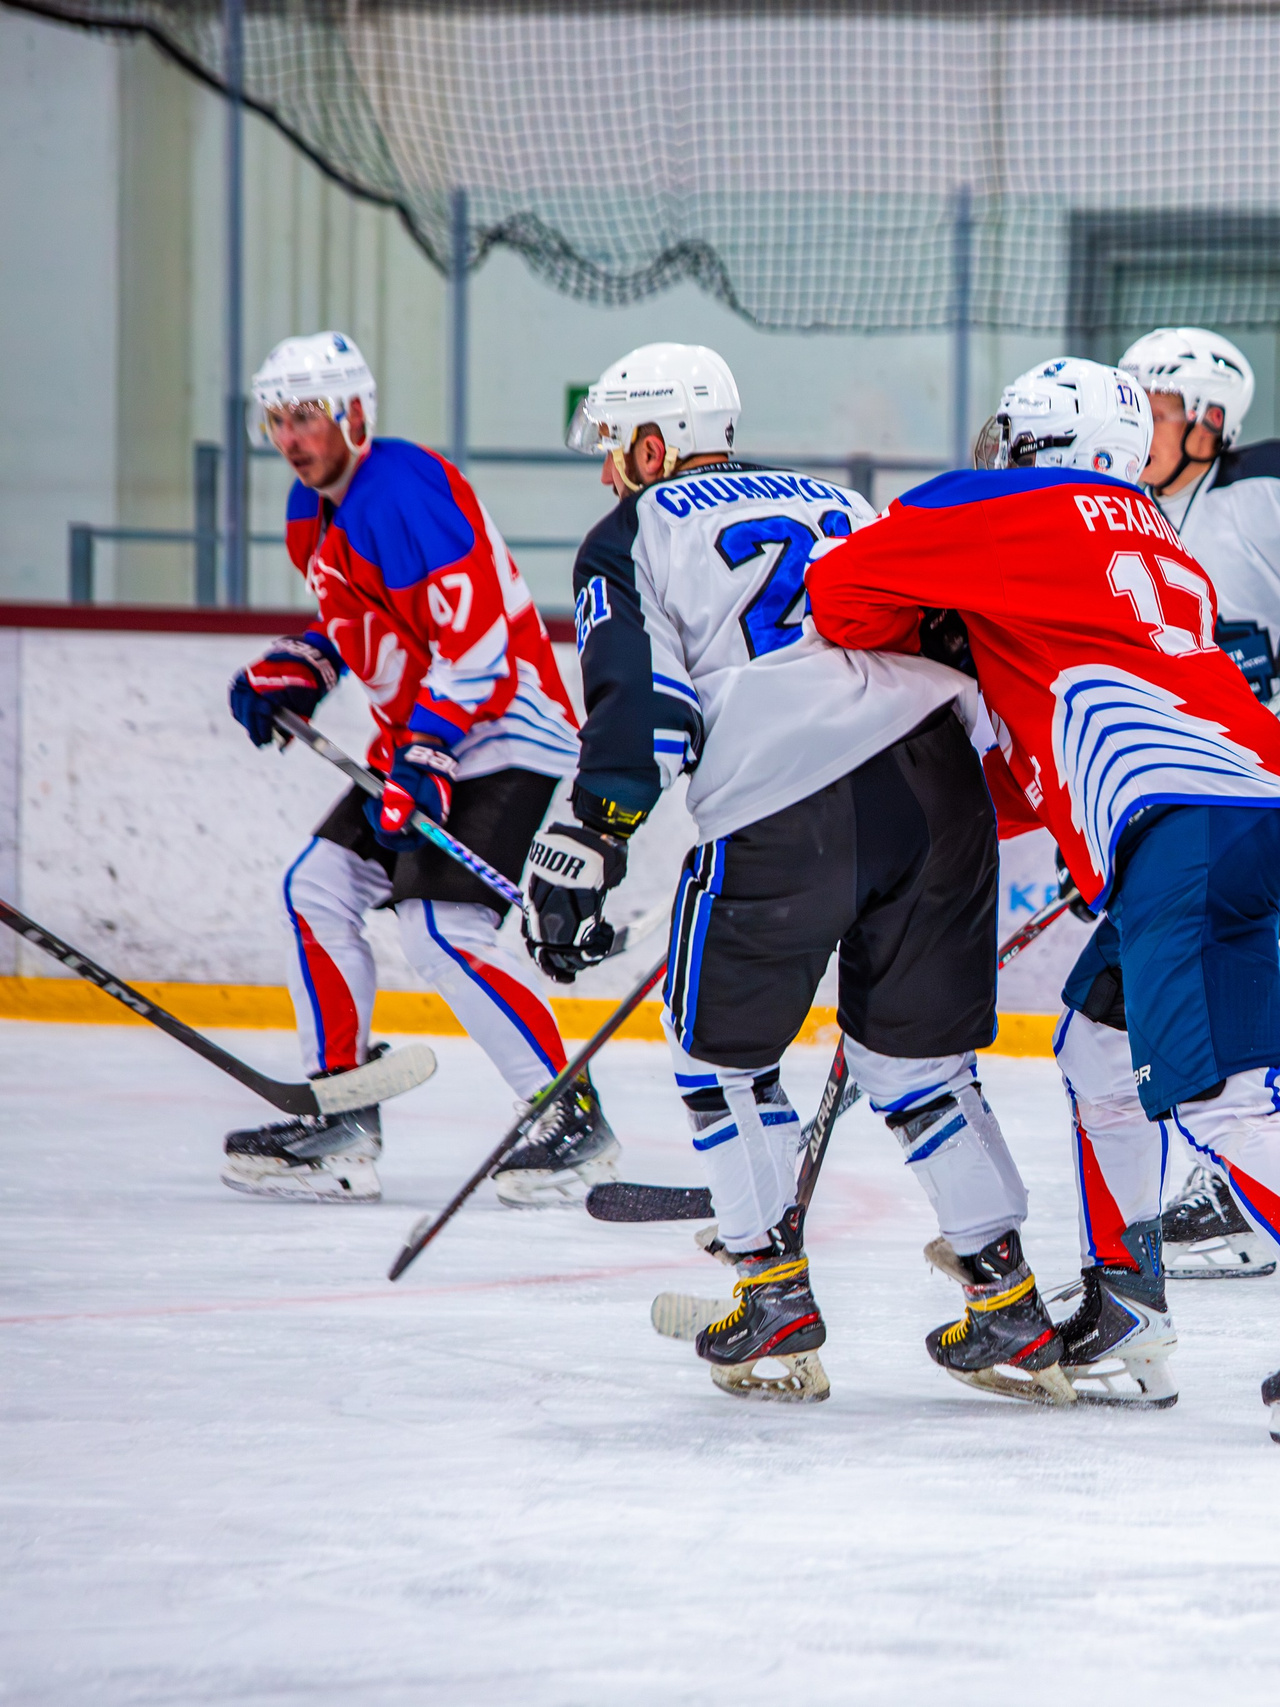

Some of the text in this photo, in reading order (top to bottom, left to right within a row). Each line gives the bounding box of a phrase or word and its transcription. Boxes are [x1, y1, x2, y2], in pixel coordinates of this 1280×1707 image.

[1117, 384, 1133, 406] 17
[427, 572, 474, 633] 47
[575, 575, 612, 656] 21
[1106, 551, 1220, 659] 17
[23, 927, 153, 1016] CCM
[809, 1080, 839, 1164] ALPHA
